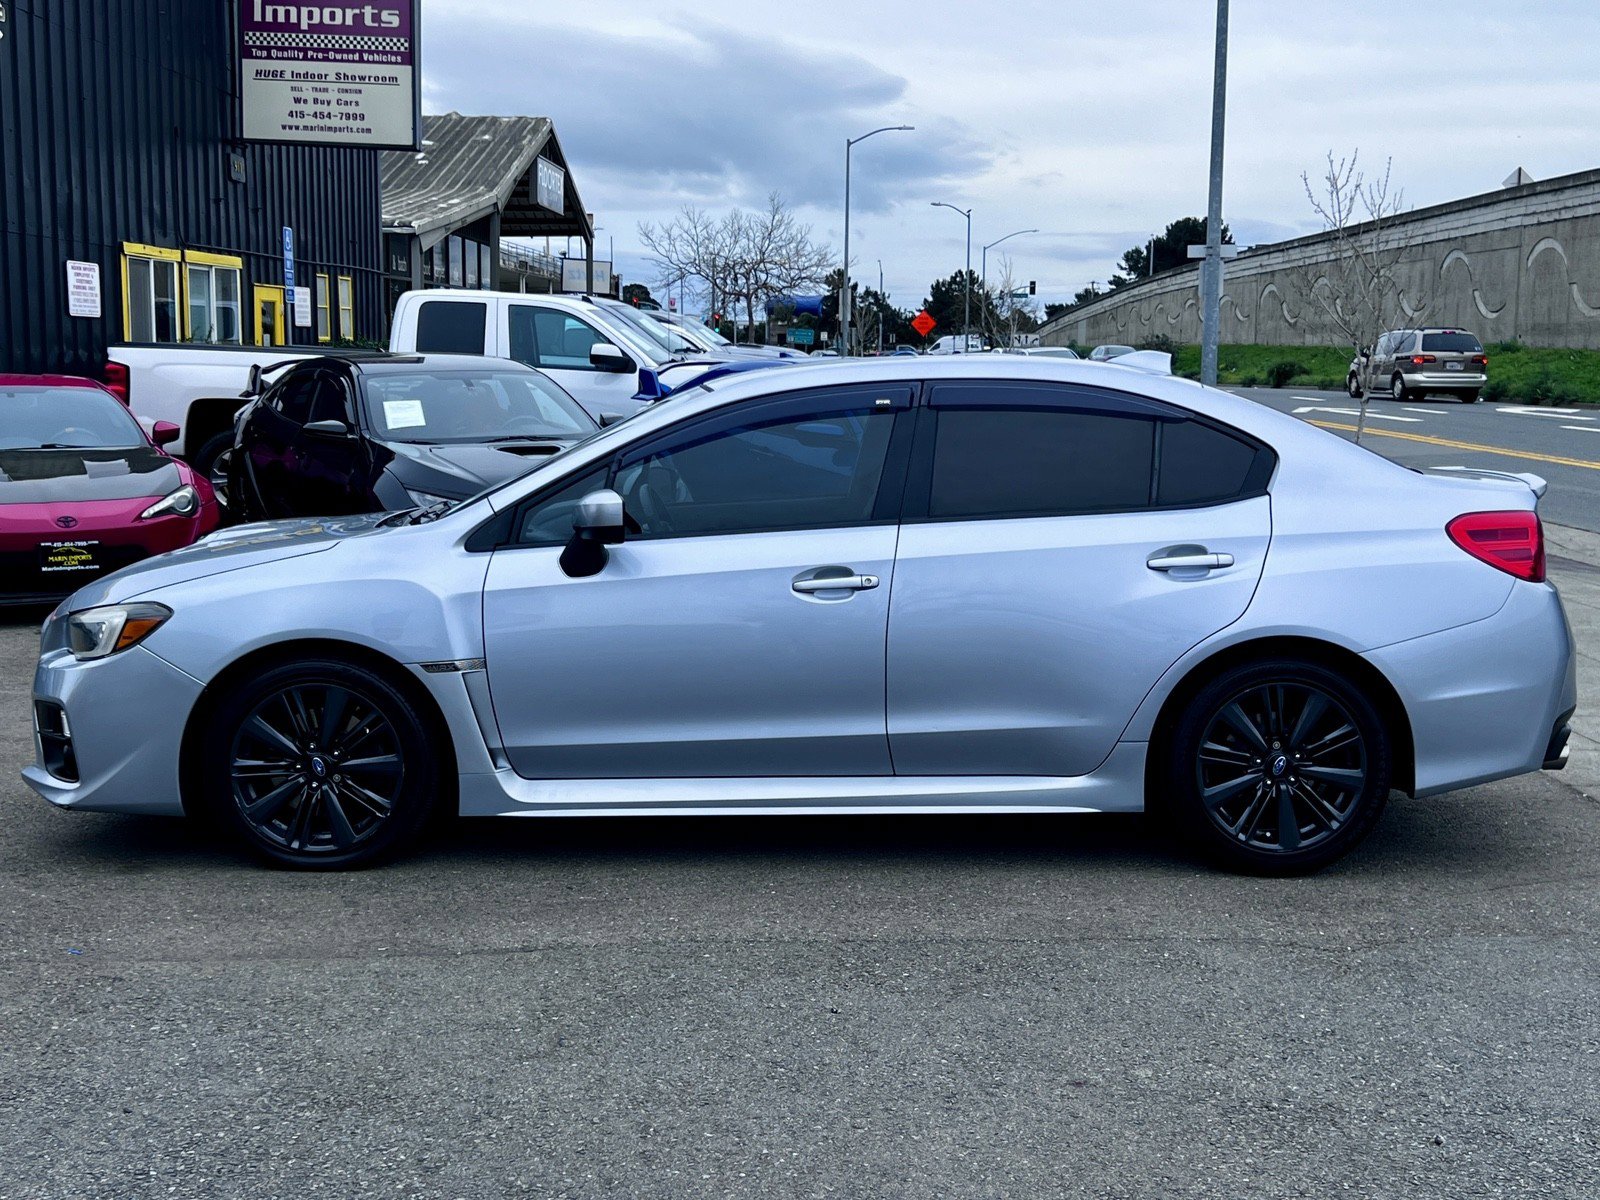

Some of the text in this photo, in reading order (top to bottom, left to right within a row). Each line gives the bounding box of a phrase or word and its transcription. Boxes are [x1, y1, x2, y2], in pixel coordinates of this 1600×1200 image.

[253, 0, 400, 31] Imports
[251, 48, 402, 63] Top Quality Pre-Owned Vehicles
[255, 69, 399, 83] HUGE Indoor Showroom
[311, 86, 329, 94] TRADE
[293, 96, 360, 107] We Buy Cars
[287, 110, 366, 122] 415-454-7999
[281, 123, 372, 135] www.marinimports.com
